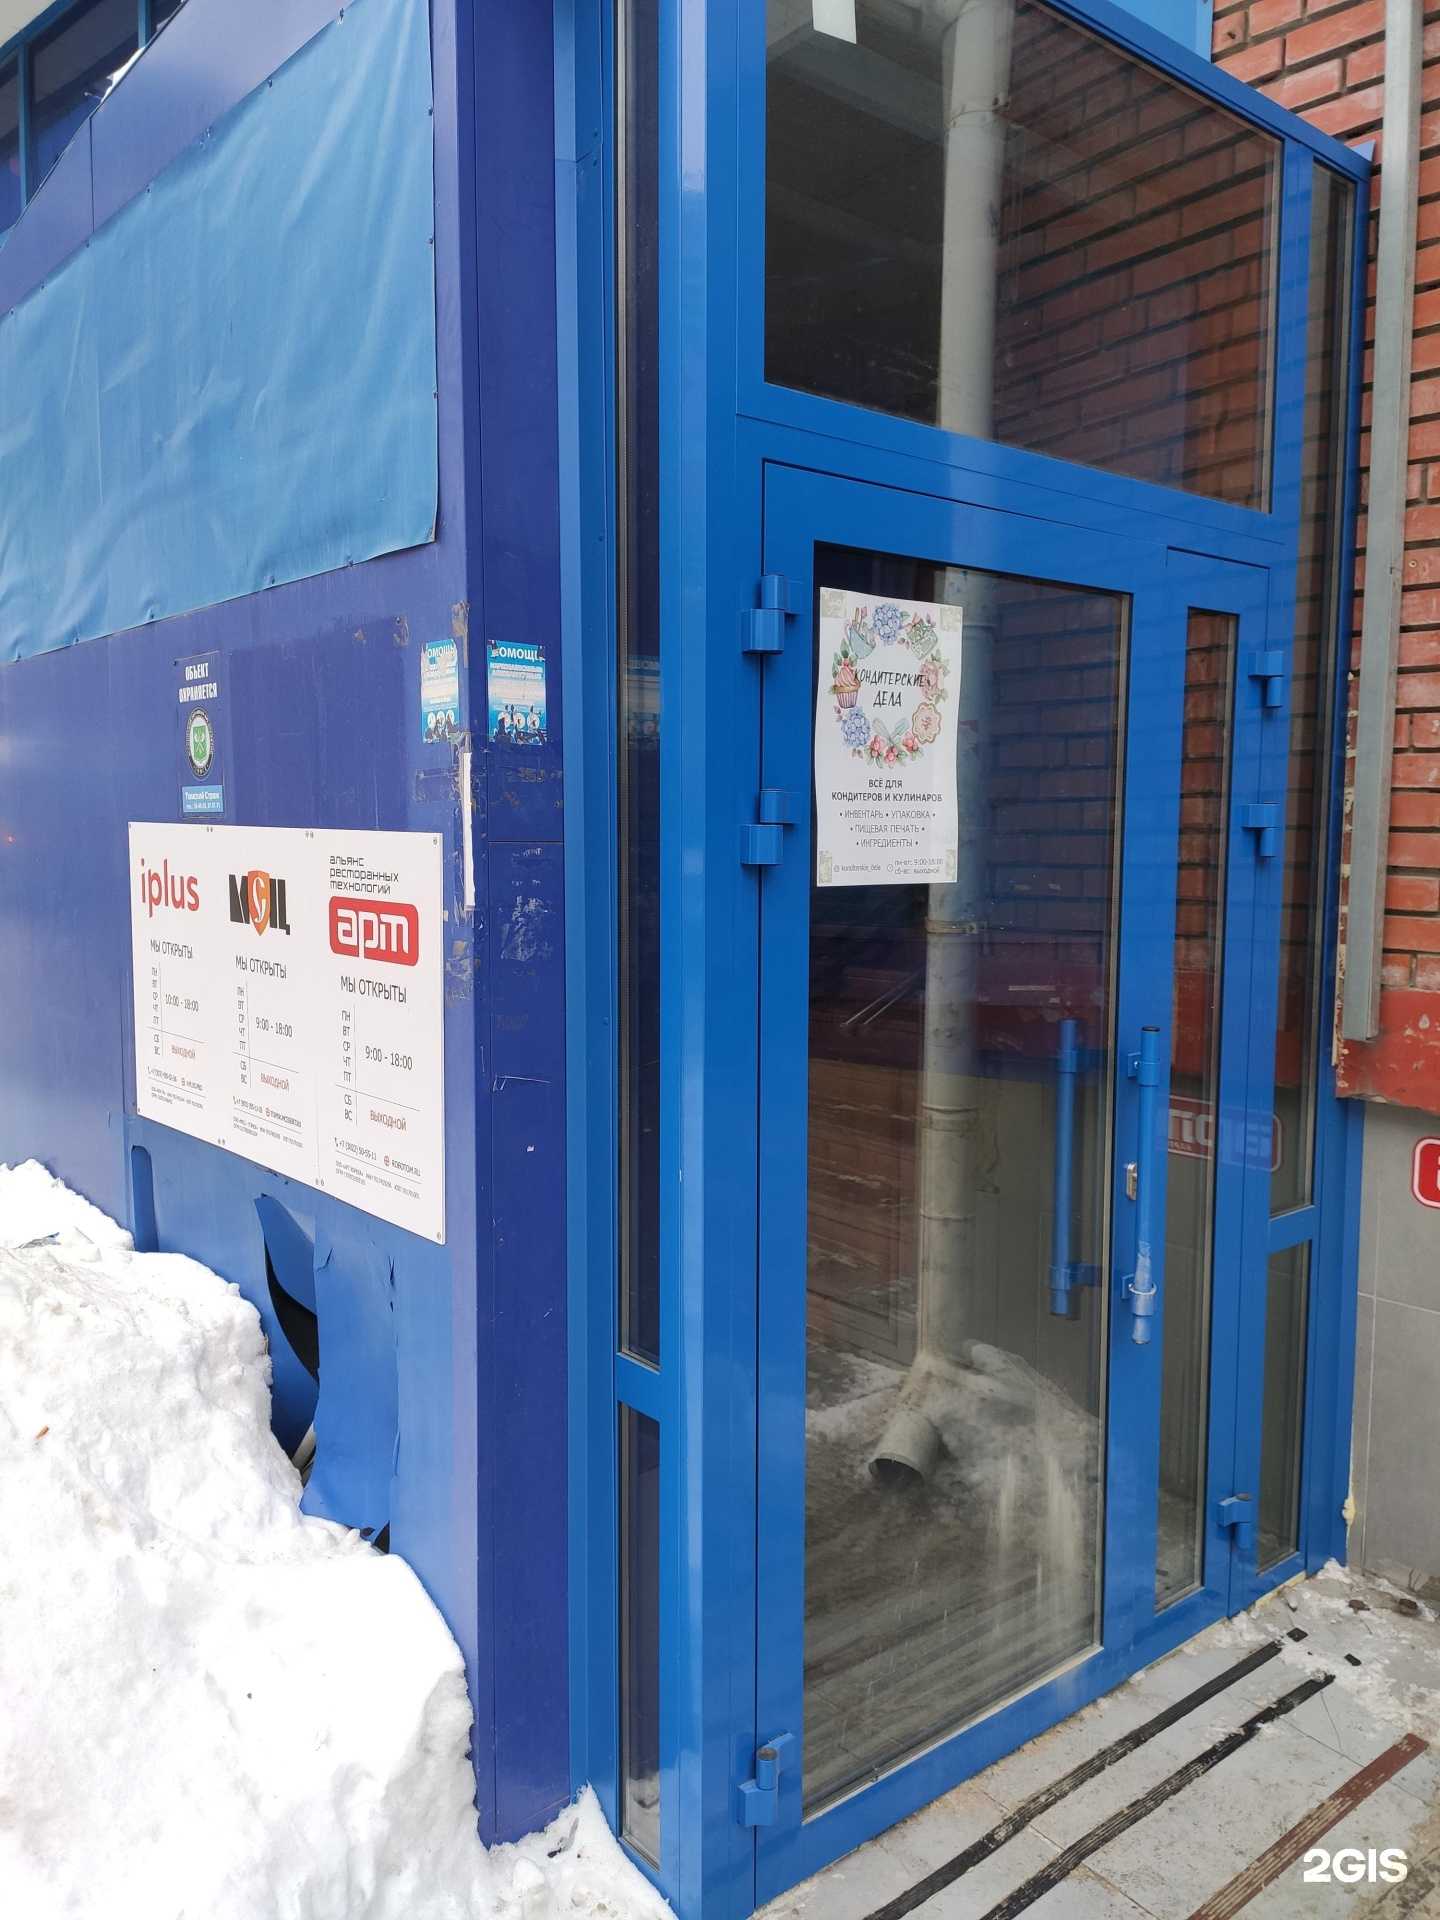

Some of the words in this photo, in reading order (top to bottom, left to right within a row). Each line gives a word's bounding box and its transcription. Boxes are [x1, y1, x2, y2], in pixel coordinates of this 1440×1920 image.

[185, 663, 208, 680] ОБЪЕКТ
[872, 690, 902, 707] ДЕЛА
[885, 779, 903, 789] ДЛЯ
[831, 791, 883, 802] КОНДИТЕРОВ
[884, 793, 891, 801] И
[893, 793, 942, 802] КУЛИНАРОВ
[844, 810, 884, 819] ИНВЕНТАРЬ
[891, 810, 930, 820] УПАКОВКА
[855, 824, 888, 834] ПИЩЕВАЯ
[890, 825, 920, 833] ПЕЧАТЬ
[860, 838, 912, 848] ИНГРЕДИЕНТЫ
[330, 855, 365, 867] альянс
[330, 867, 399, 882] ресторанных
[141, 858, 200, 918] iplus
[330, 880, 391, 894] технологий
[162, 941, 192, 959] ОТКРЫТЫ
[236, 955, 247, 971] МЫ
[250, 958, 286, 979] ОТКРЫТЫ
[341, 975, 355, 993] МЫ
[359, 979, 407, 1004] ОТКРЫТЫ
[342, 1010, 350, 1022] ПН
[275, 1021, 293, 1038] 18:00
[343, 1026, 350, 1036] ВТ
[365, 1045, 382, 1062] 9:00
[391, 1053, 413, 1070] 18:00
[345, 1109, 352, 1121] ВС
[370, 1110, 407, 1131] ВЫХОДНОЙ
